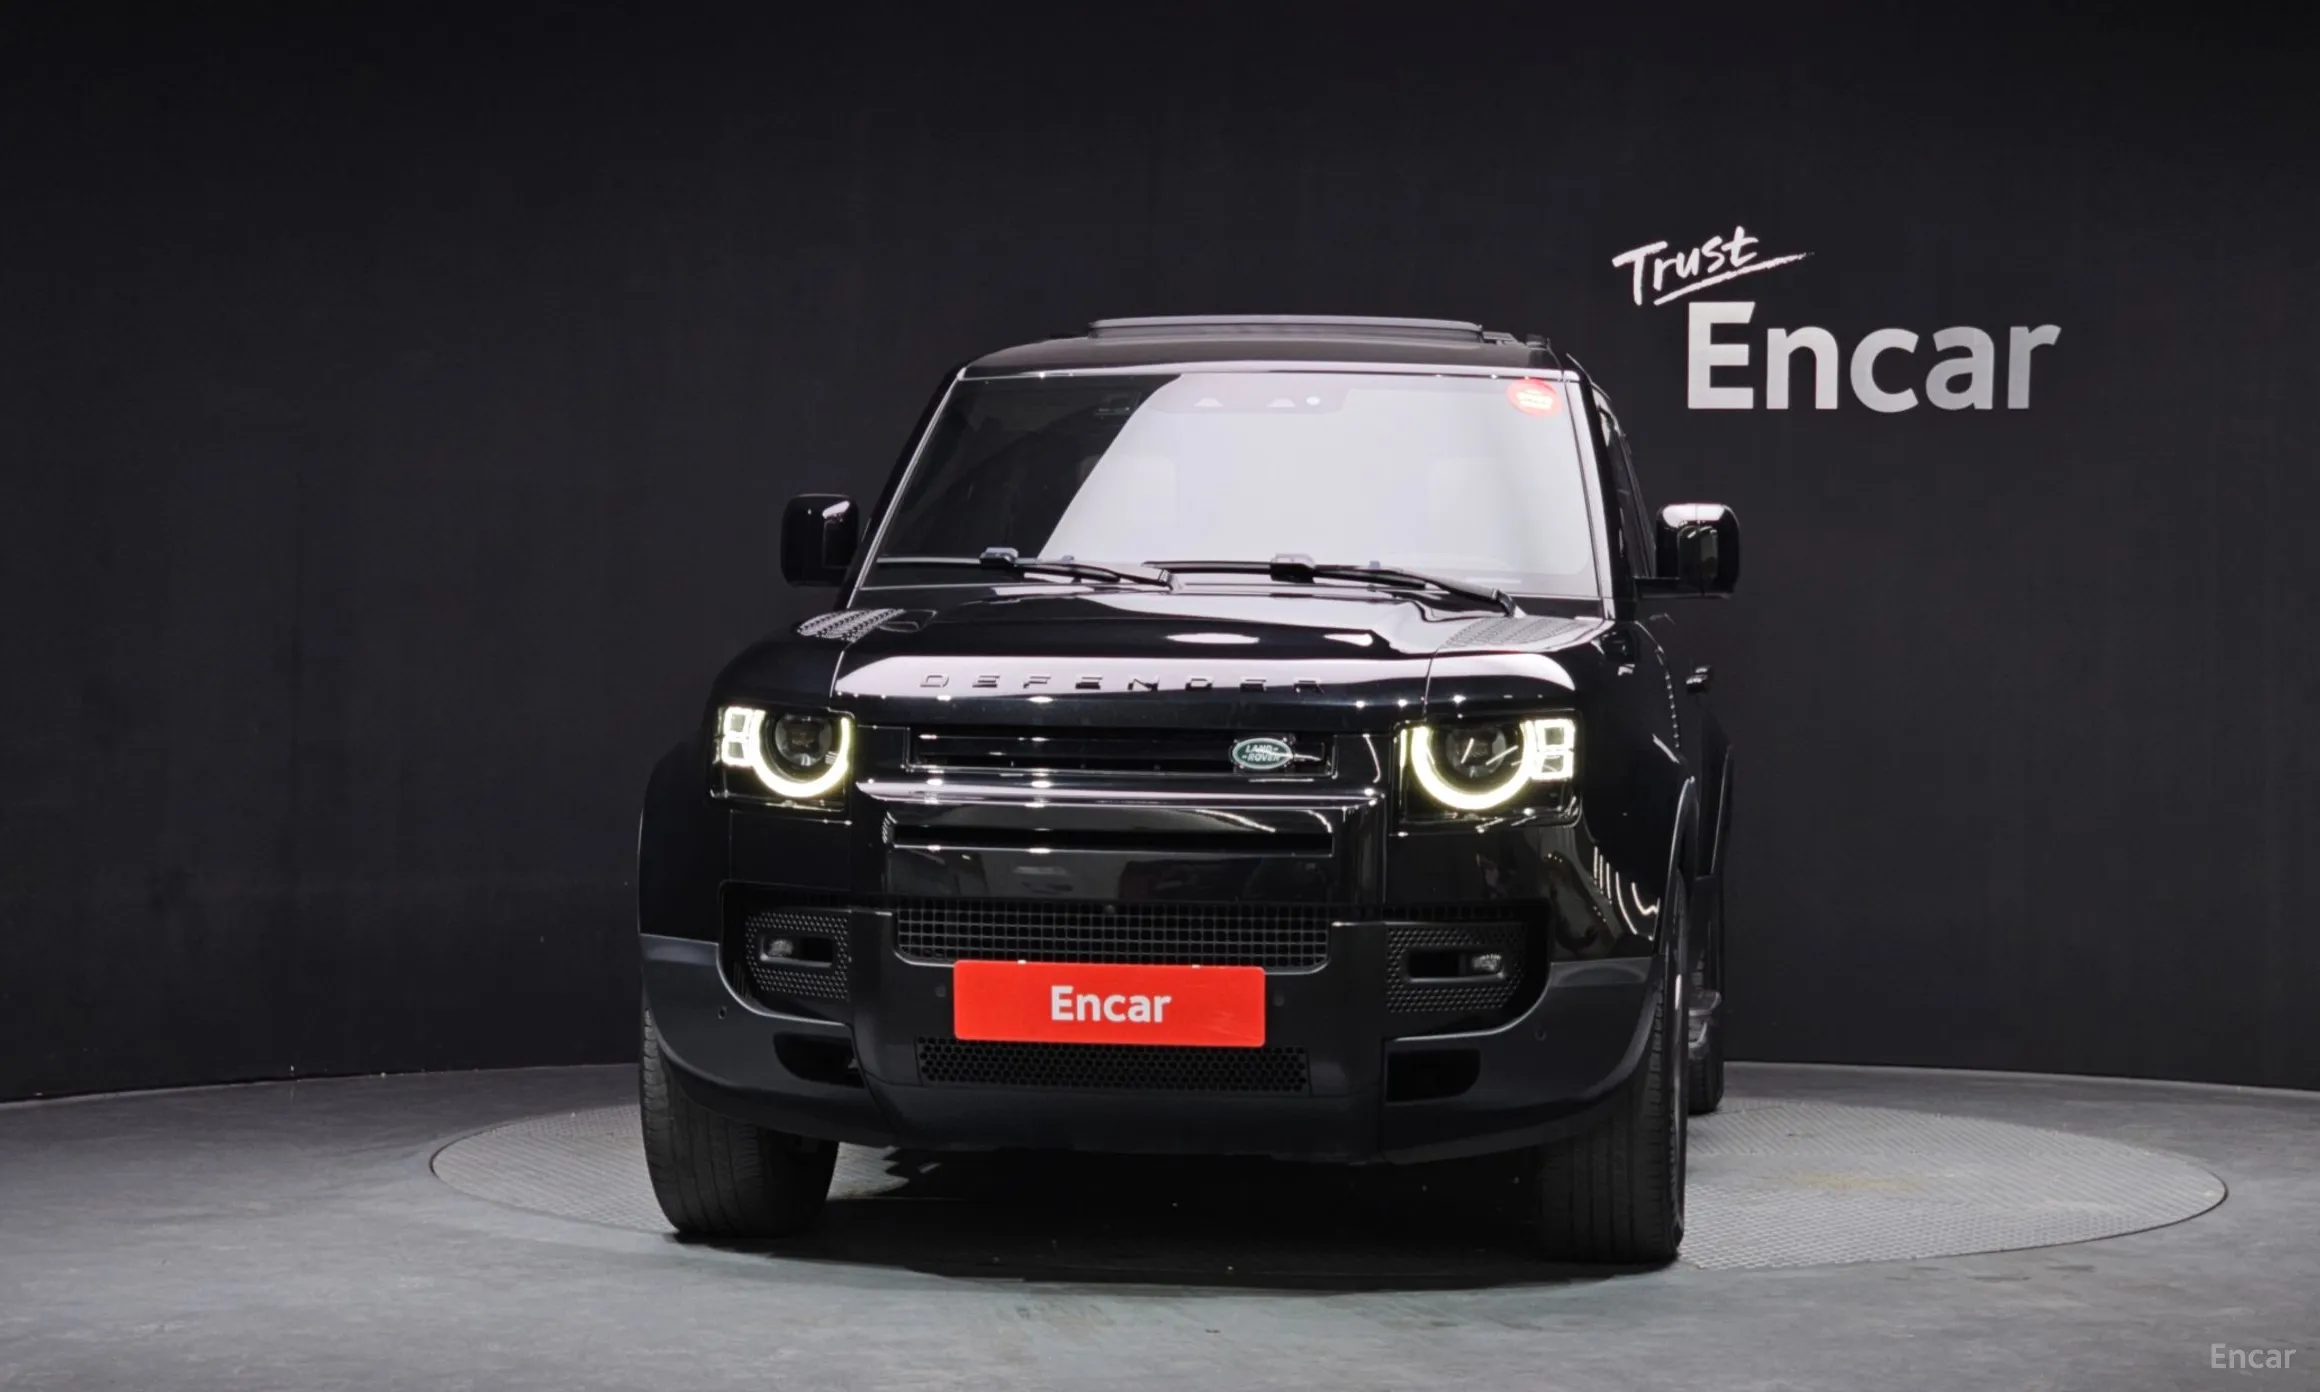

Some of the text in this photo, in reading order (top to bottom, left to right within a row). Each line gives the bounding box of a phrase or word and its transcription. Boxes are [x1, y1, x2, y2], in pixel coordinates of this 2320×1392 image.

[1612, 226, 1760, 305] Trust
[1687, 301, 2061, 412] Encar
[920, 674, 1325, 694] DEFENDER
[1051, 985, 1172, 1023] Encar
